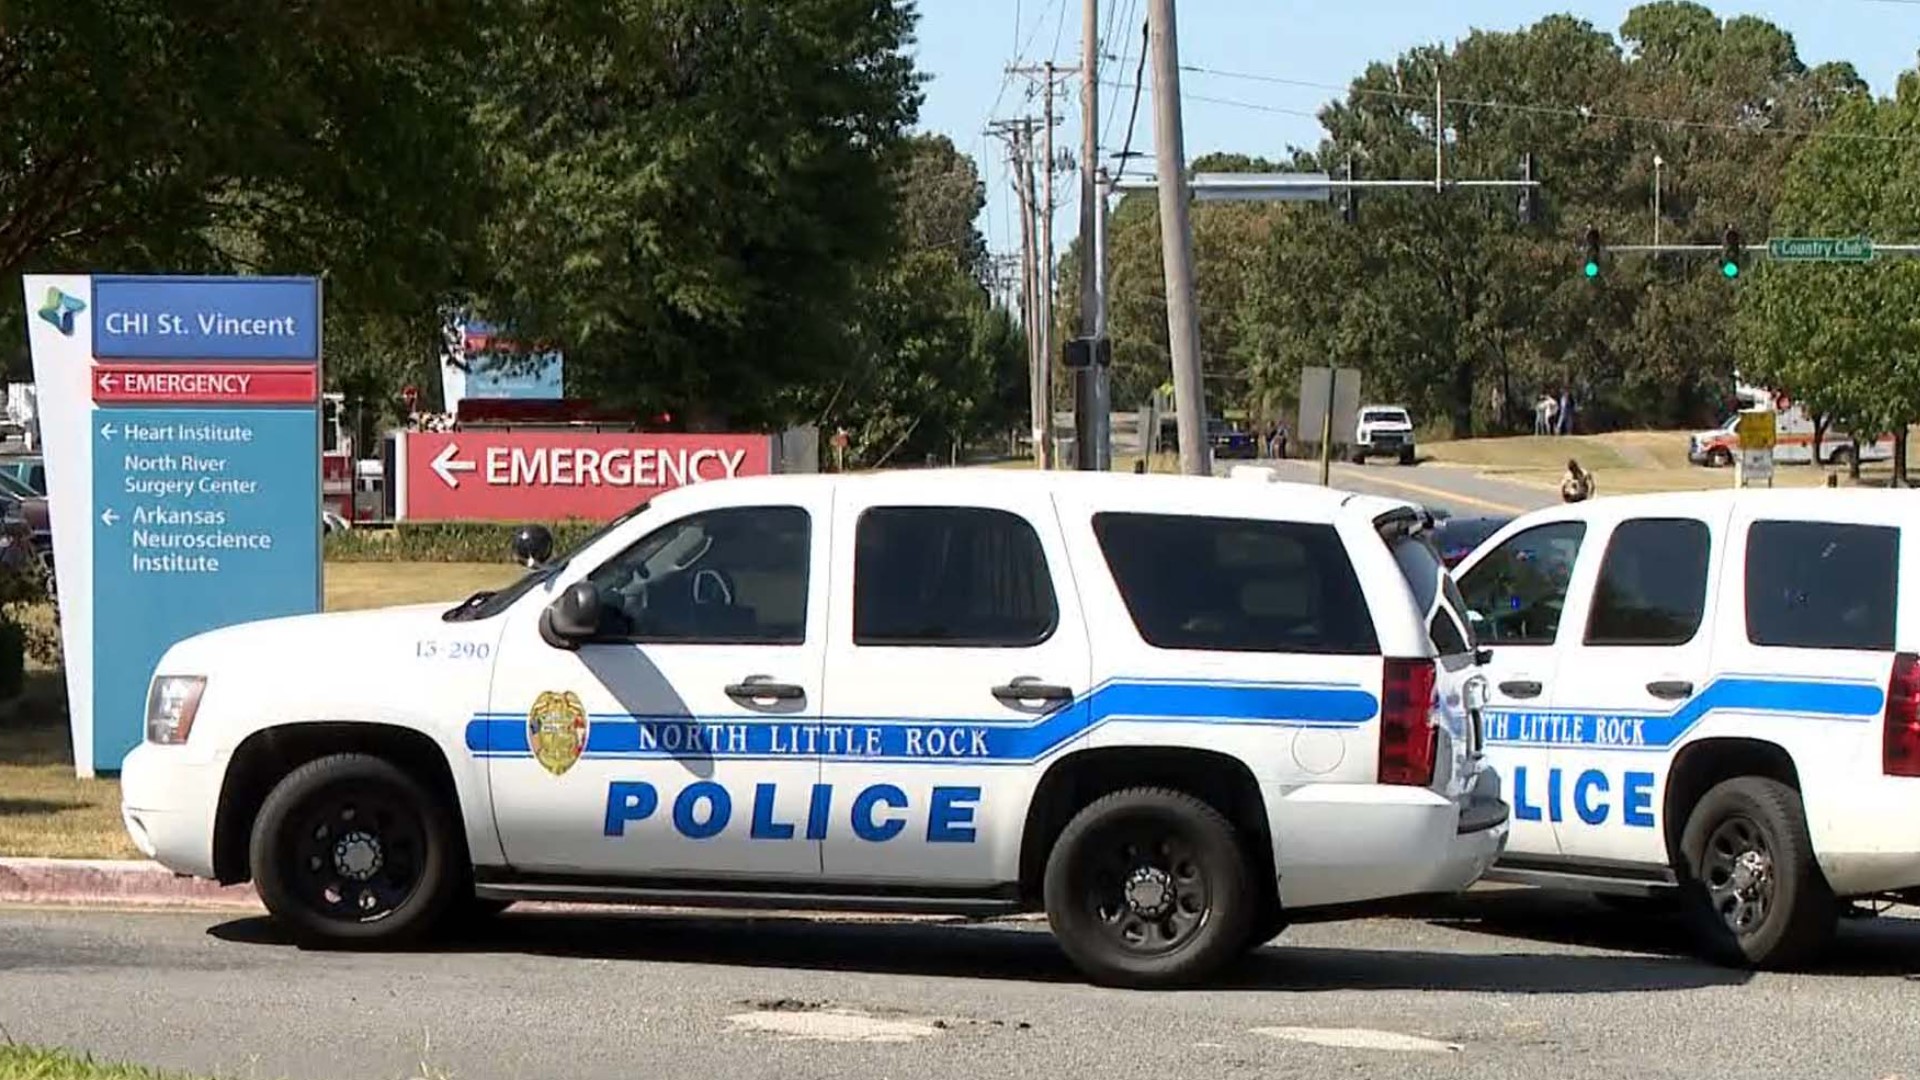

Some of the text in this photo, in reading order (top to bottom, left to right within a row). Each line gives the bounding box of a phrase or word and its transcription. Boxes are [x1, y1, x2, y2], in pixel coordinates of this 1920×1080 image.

[1782, 241, 1833, 258] Country
[1835, 241, 1861, 255] Club
[105, 312, 296, 336] CHI St. Vincent
[124, 374, 251, 393] EMERGENCY
[124, 424, 252, 442] Heart Institute
[124, 455, 226, 472] North River
[485, 446, 746, 486] EMERGENCY
[124, 477, 256, 498] Surgery Center
[132, 506, 225, 525] Arkansas
[132, 530, 272, 549] Neuroscience
[132, 554, 219, 572] Institute
[638, 723, 990, 756] NORTH LITTLE ROCK
[1520, 716, 1583, 741] LITTLE
[1595, 718, 1646, 745] ROCK
[1514, 766, 1655, 828] LICE
[603, 780, 983, 843] POLICE
